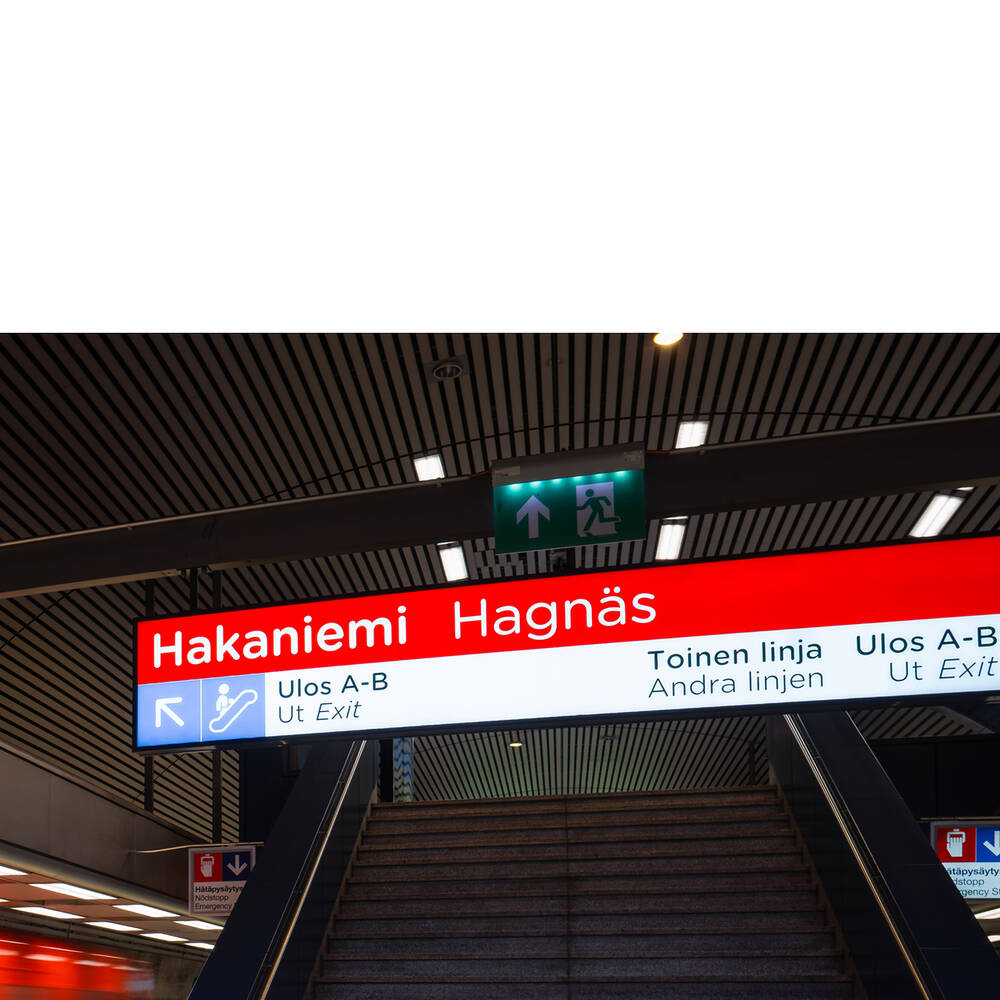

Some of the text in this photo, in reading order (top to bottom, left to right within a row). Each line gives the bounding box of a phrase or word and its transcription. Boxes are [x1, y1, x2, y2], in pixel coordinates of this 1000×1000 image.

[153, 586, 657, 668] Hakaniemi Hagnäs
[856, 626, 998, 656] Ulos A-B
[648, 639, 823, 671] Toinen linja
[889, 656, 998, 683] Ut Exit
[278, 672, 388, 699] Ulos A-B
[648, 667, 824, 699] Andra linjen
[278, 700, 362, 724] Ut Exit
